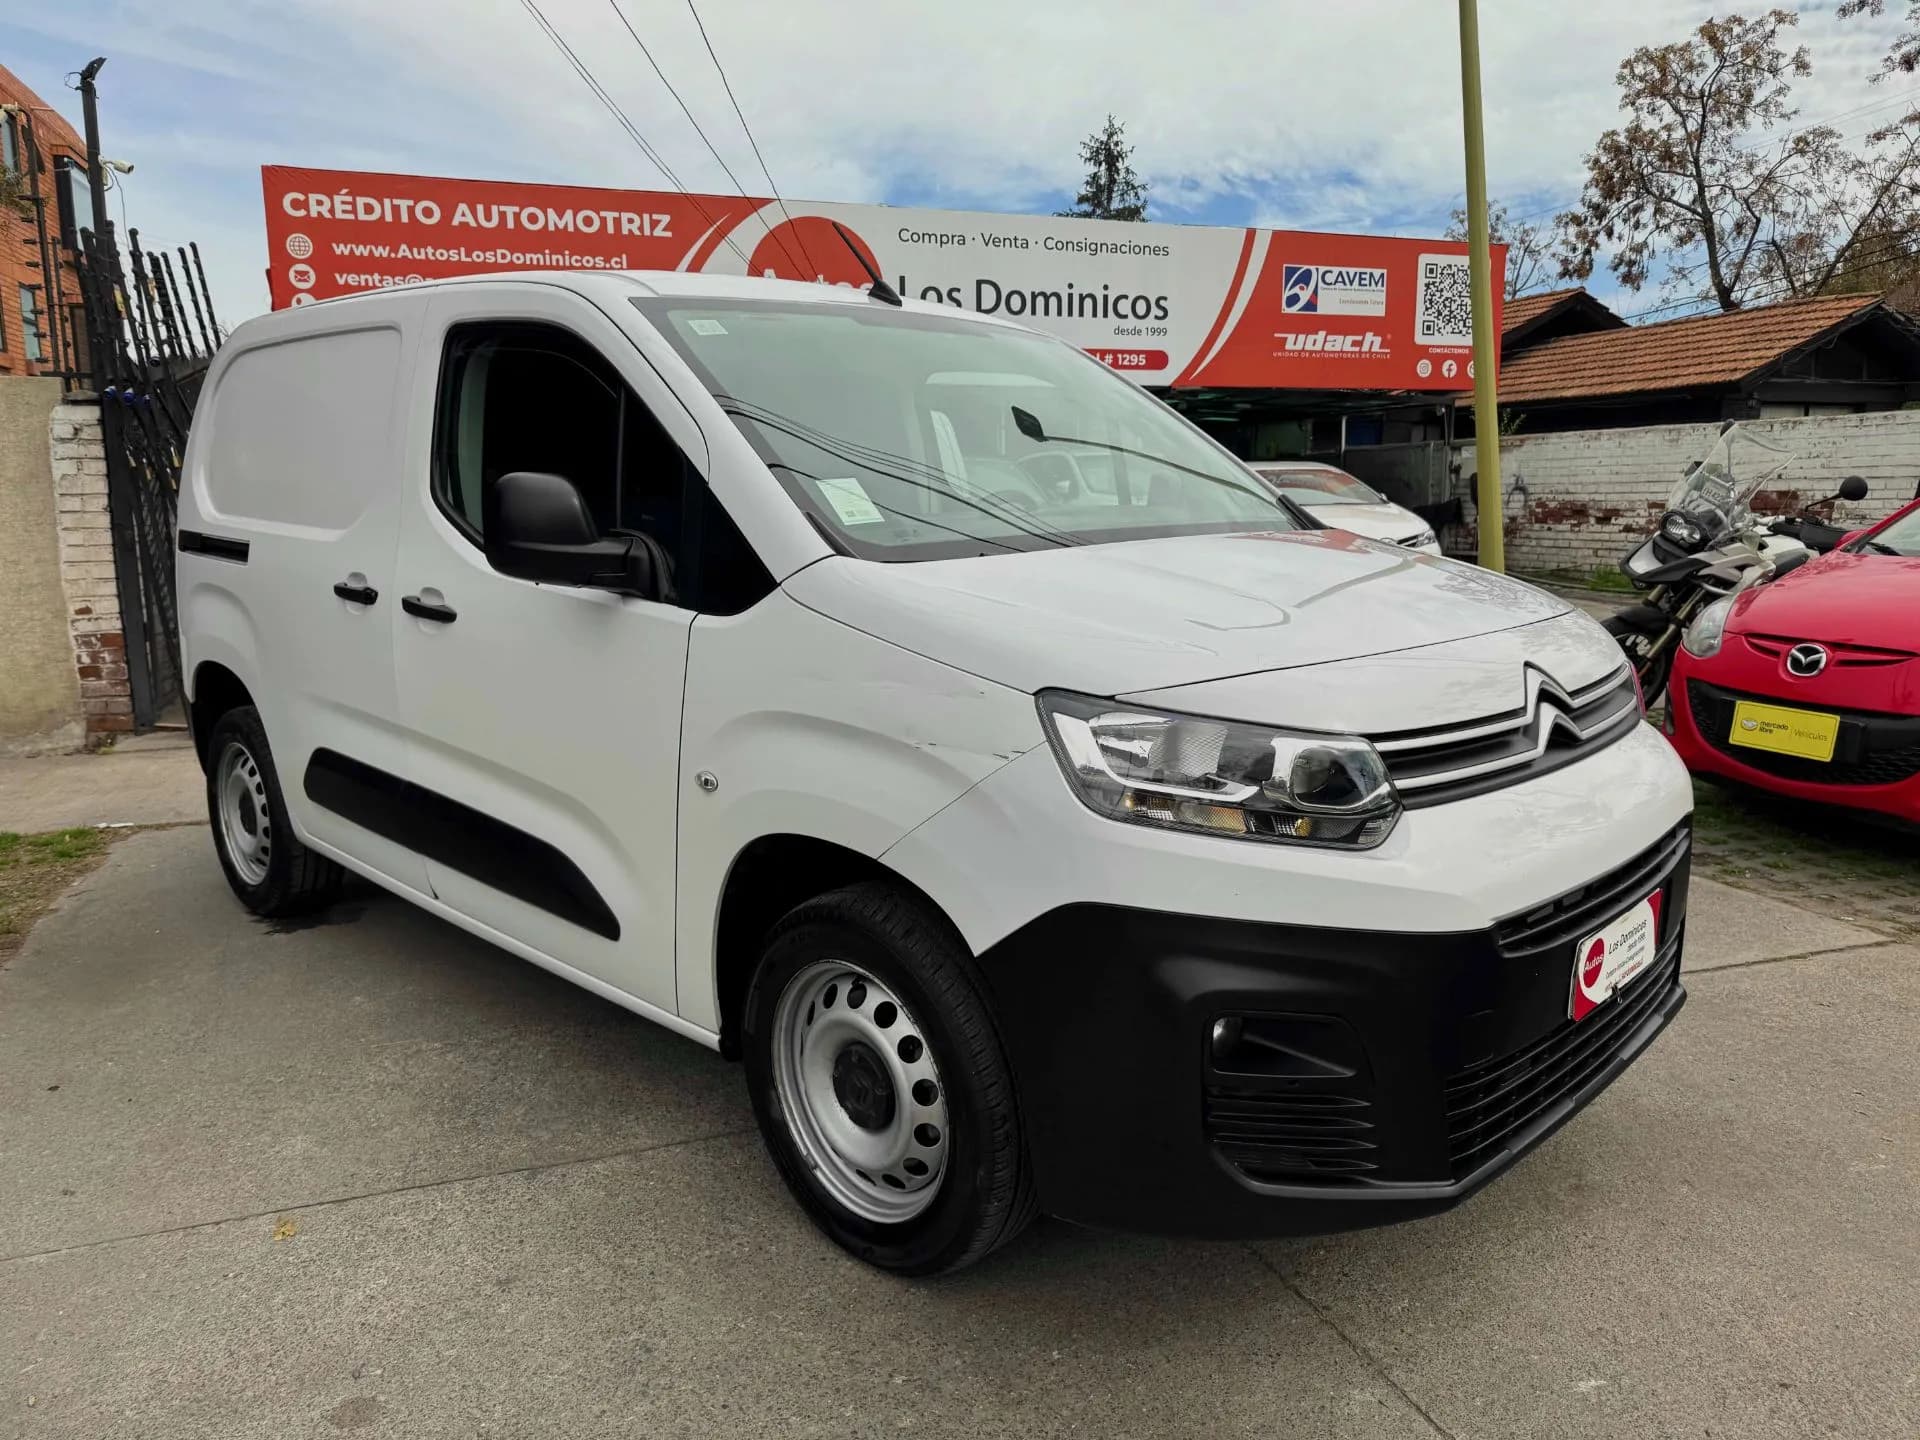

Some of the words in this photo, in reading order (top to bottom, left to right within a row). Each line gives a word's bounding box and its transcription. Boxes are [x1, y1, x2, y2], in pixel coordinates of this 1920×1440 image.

[282, 188, 441, 224] CRÉDITO
[451, 203, 673, 238] AUTOMOTRIZ
[898, 227, 966, 247] Compra
[980, 233, 1029, 249] Venta
[1043, 236, 1170, 256] Consignaciones
[332, 240, 628, 269] www.AutosLosDominicos.cl
[334, 272, 435, 287] ventas@
[1321, 270, 1385, 287] CAVEM
[975, 279, 1169, 321] Dominicos
[1113, 325, 1142, 336] desde
[1145, 327, 1168, 337] 1999
[1117, 353, 1146, 366] 1295
